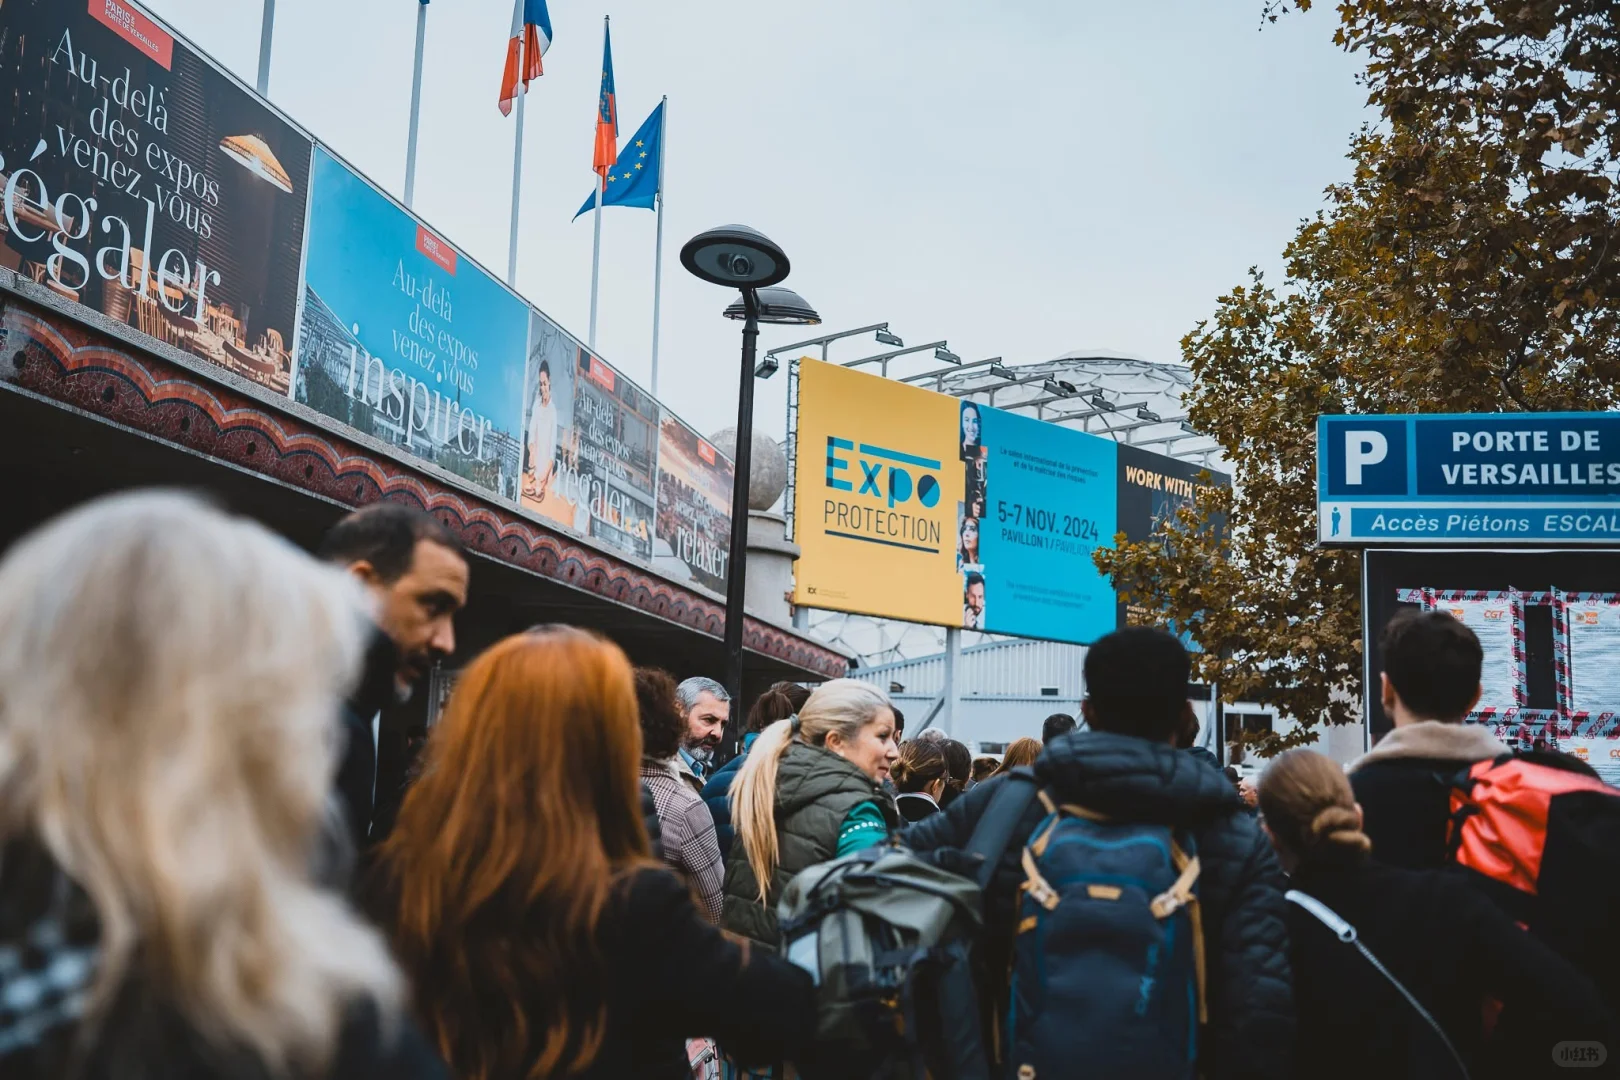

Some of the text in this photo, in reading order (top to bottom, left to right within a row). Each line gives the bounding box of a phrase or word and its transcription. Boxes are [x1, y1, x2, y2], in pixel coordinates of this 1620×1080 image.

[105, 0, 131, 24] PARIS
[105, 8, 122, 26] PORTE
[122, 20, 130, 32] DE
[130, 26, 159, 53] VERSAILLES
[50, 27, 169, 136] Au-delà
[89, 96, 220, 207] des expos
[55, 124, 214, 240] venez vous
[0, 138, 221, 325] égaler
[392, 258, 452, 324] Au-delà
[408, 303, 479, 371] des expos
[391, 328, 474, 396] venez vous
[344, 322, 492, 463] inspirer
[578, 387, 614, 429] Au-delà
[588, 417, 630, 462] des expos
[1345, 430, 1388, 485] P
[1452, 430, 1600, 453] PORTE DE
[1126, 465, 1162, 491] WORK
[1164, 475, 1193, 498] WITH
[1441, 463, 1620, 485] VERSAILLES
[824, 499, 941, 545] PROTECTION
[998, 500, 1099, 542] 5-7 NOV. 2024
[1001, 528, 1043, 549] PAVILLON
[1370, 513, 1440, 532] Accès
[1446, 513, 1530, 532] Piétons
[676, 519, 729, 580] relaxer
[1483, 610, 1505, 619] CGT
